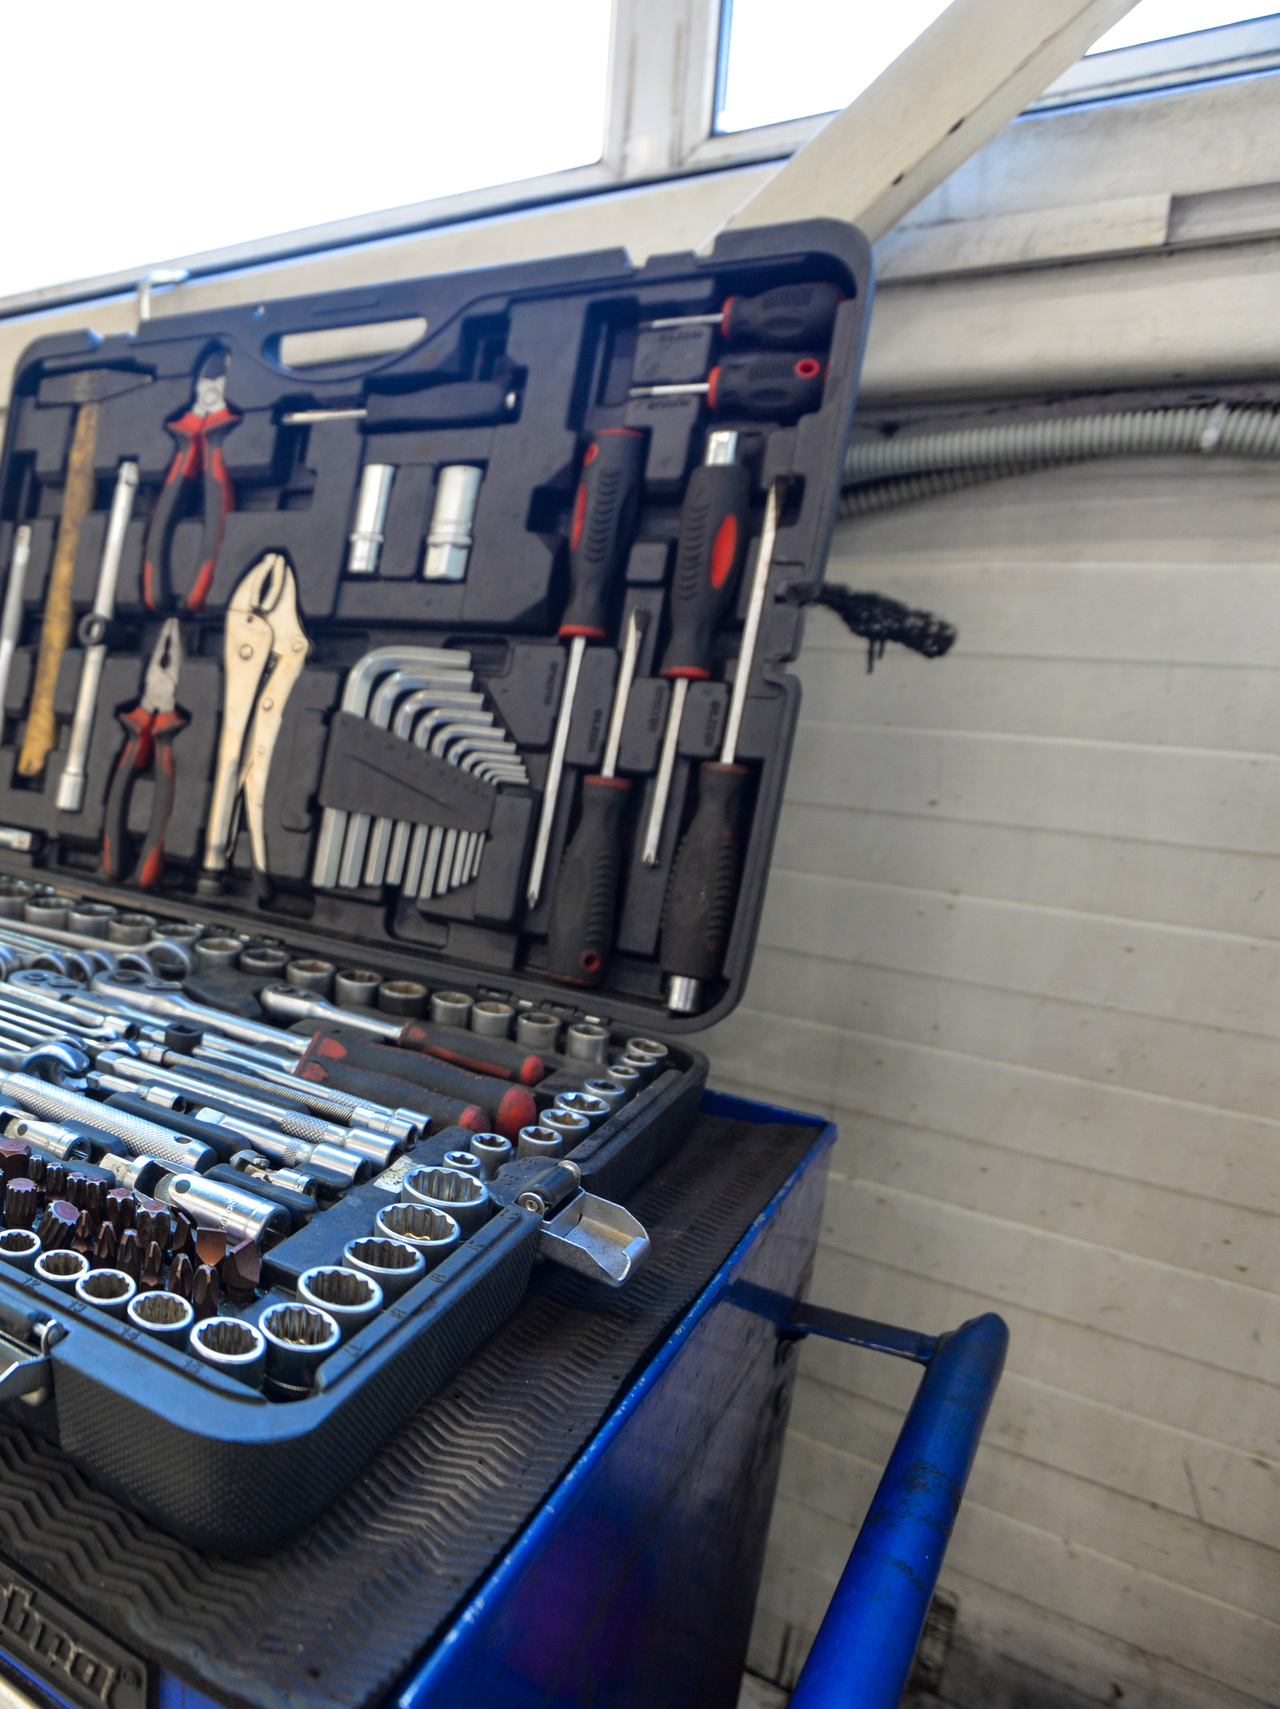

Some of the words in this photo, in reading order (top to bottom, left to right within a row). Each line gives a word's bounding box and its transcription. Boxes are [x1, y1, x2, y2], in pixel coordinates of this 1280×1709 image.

[465, 1239, 485, 1252] 21
[22, 1276, 42, 1288] 12
[428, 1273, 447, 1284] 19
[121, 1326, 141, 1342] 14
